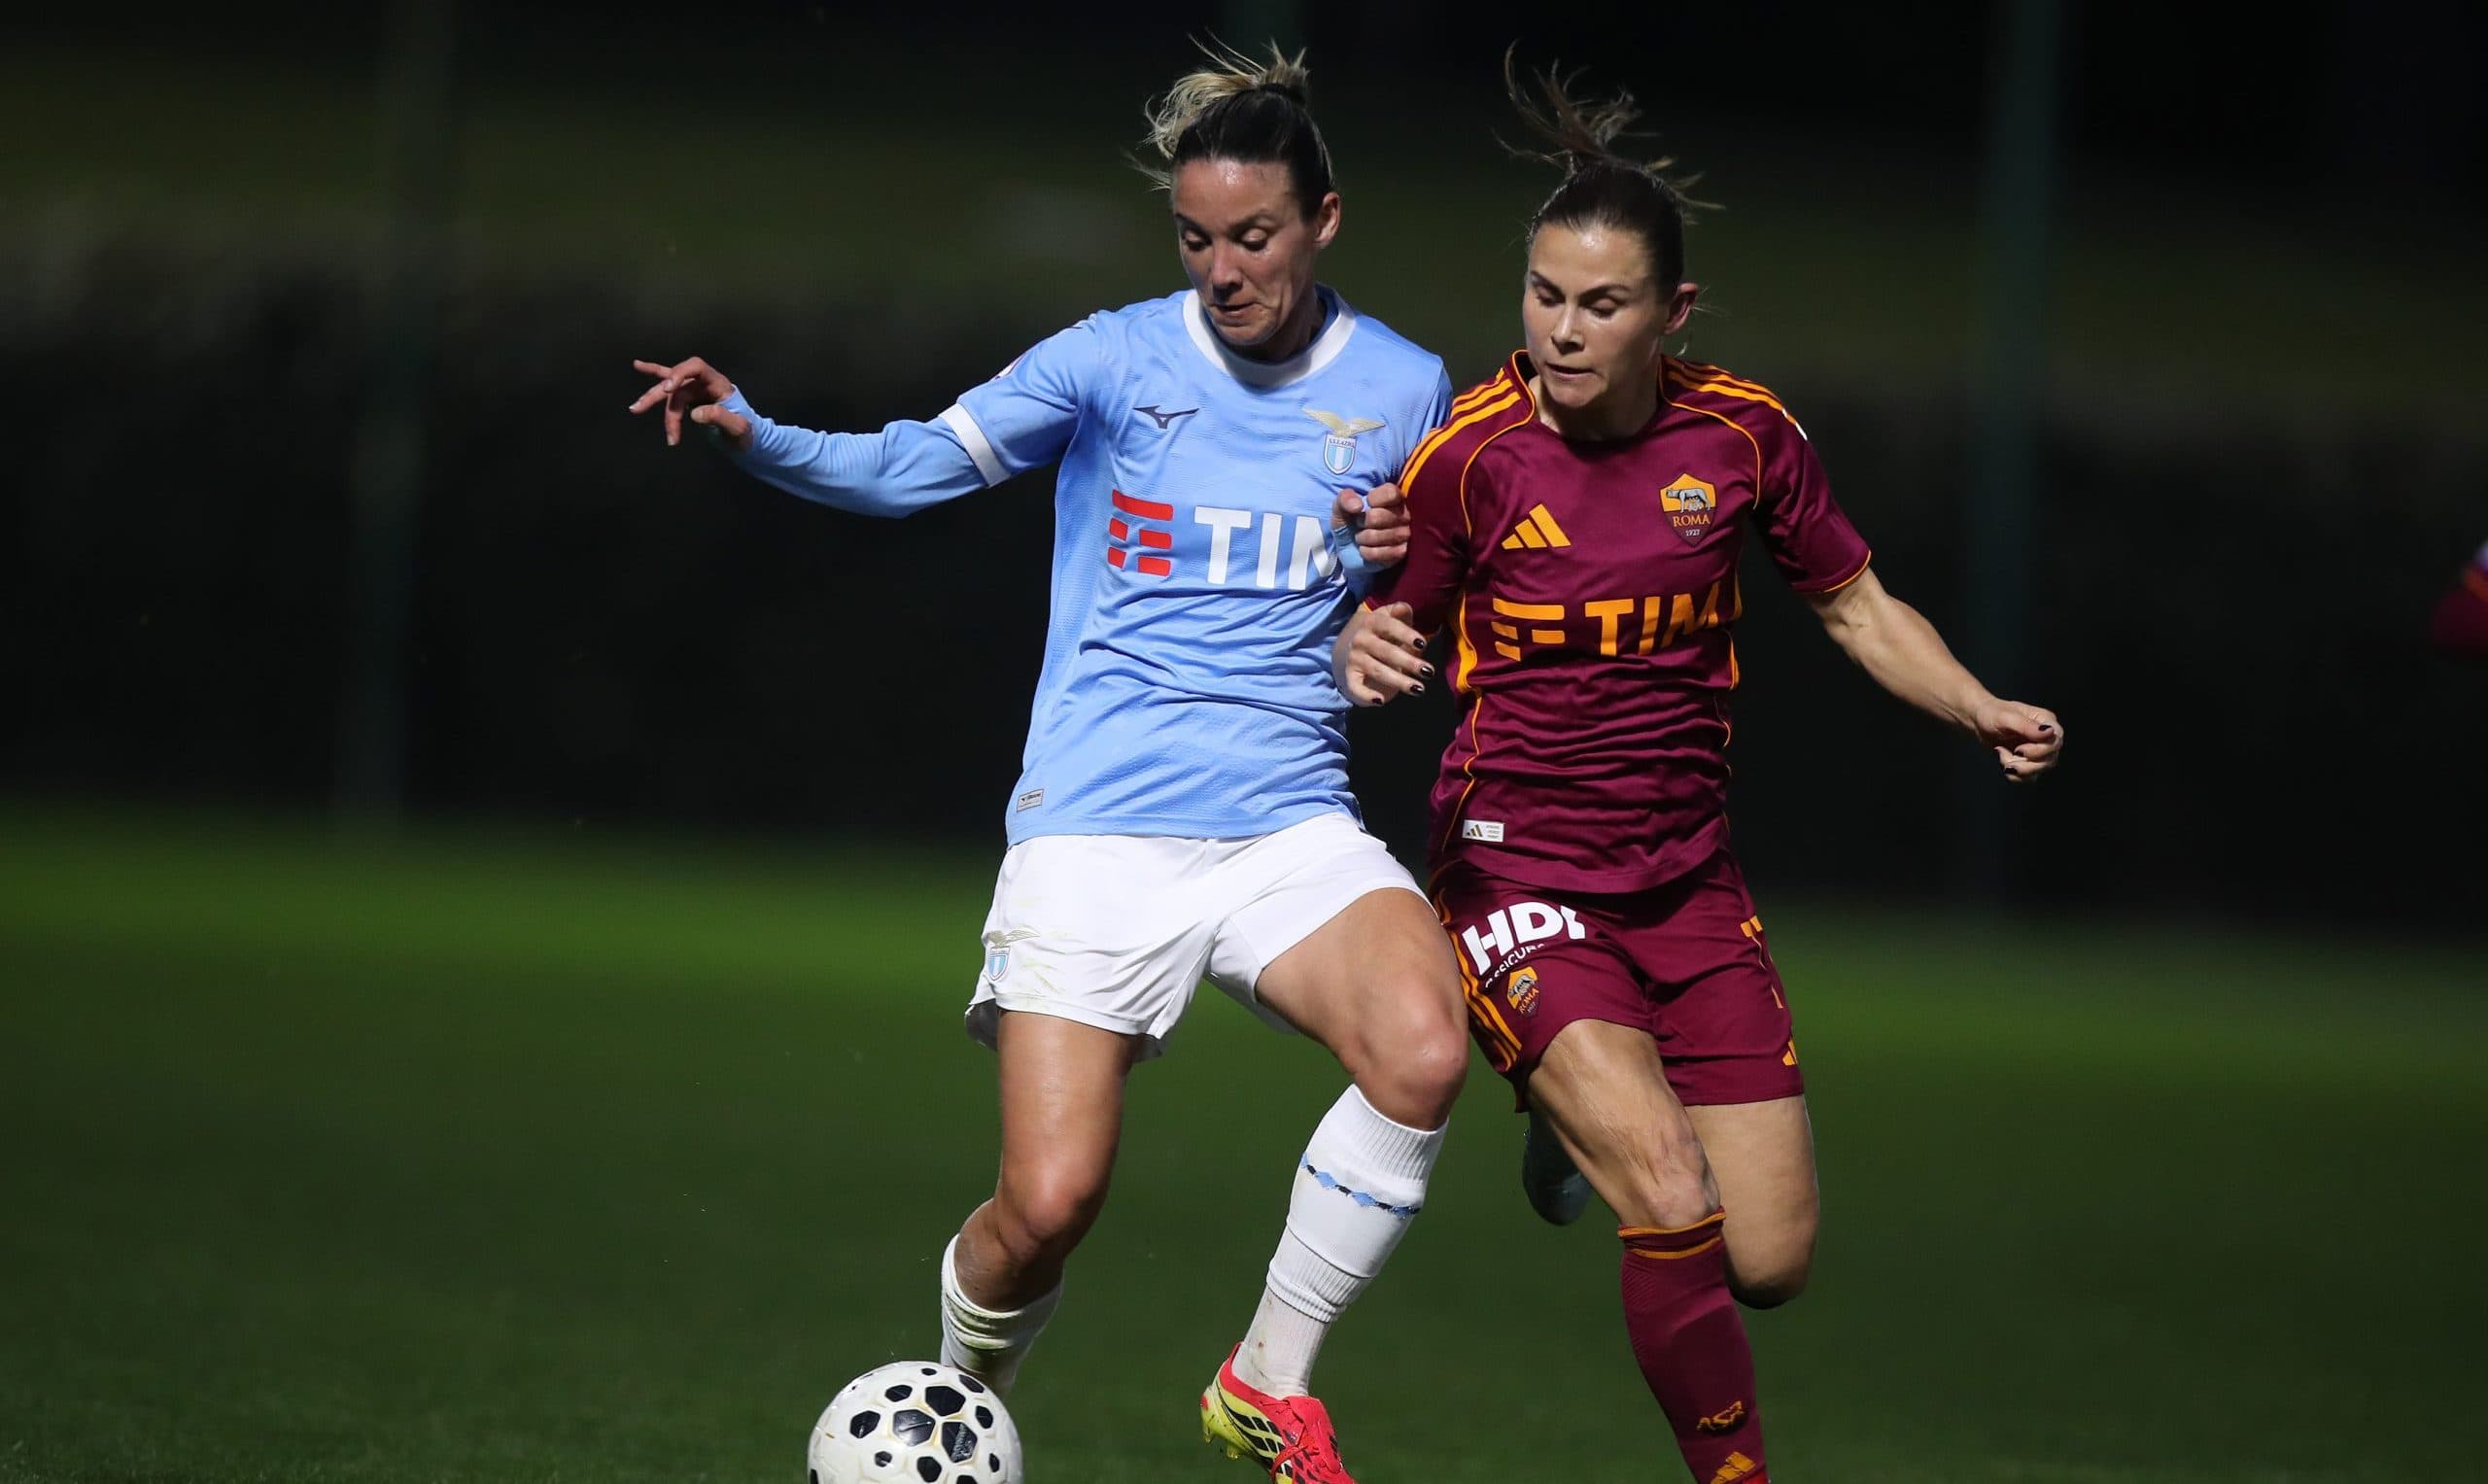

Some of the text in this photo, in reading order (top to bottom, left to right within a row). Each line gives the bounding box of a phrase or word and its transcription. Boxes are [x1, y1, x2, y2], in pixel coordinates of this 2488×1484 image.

[1673, 513, 1710, 528] ROMA
[1585, 580, 1719, 657] TIM
[1518, 987, 1539, 1014] ROMA
